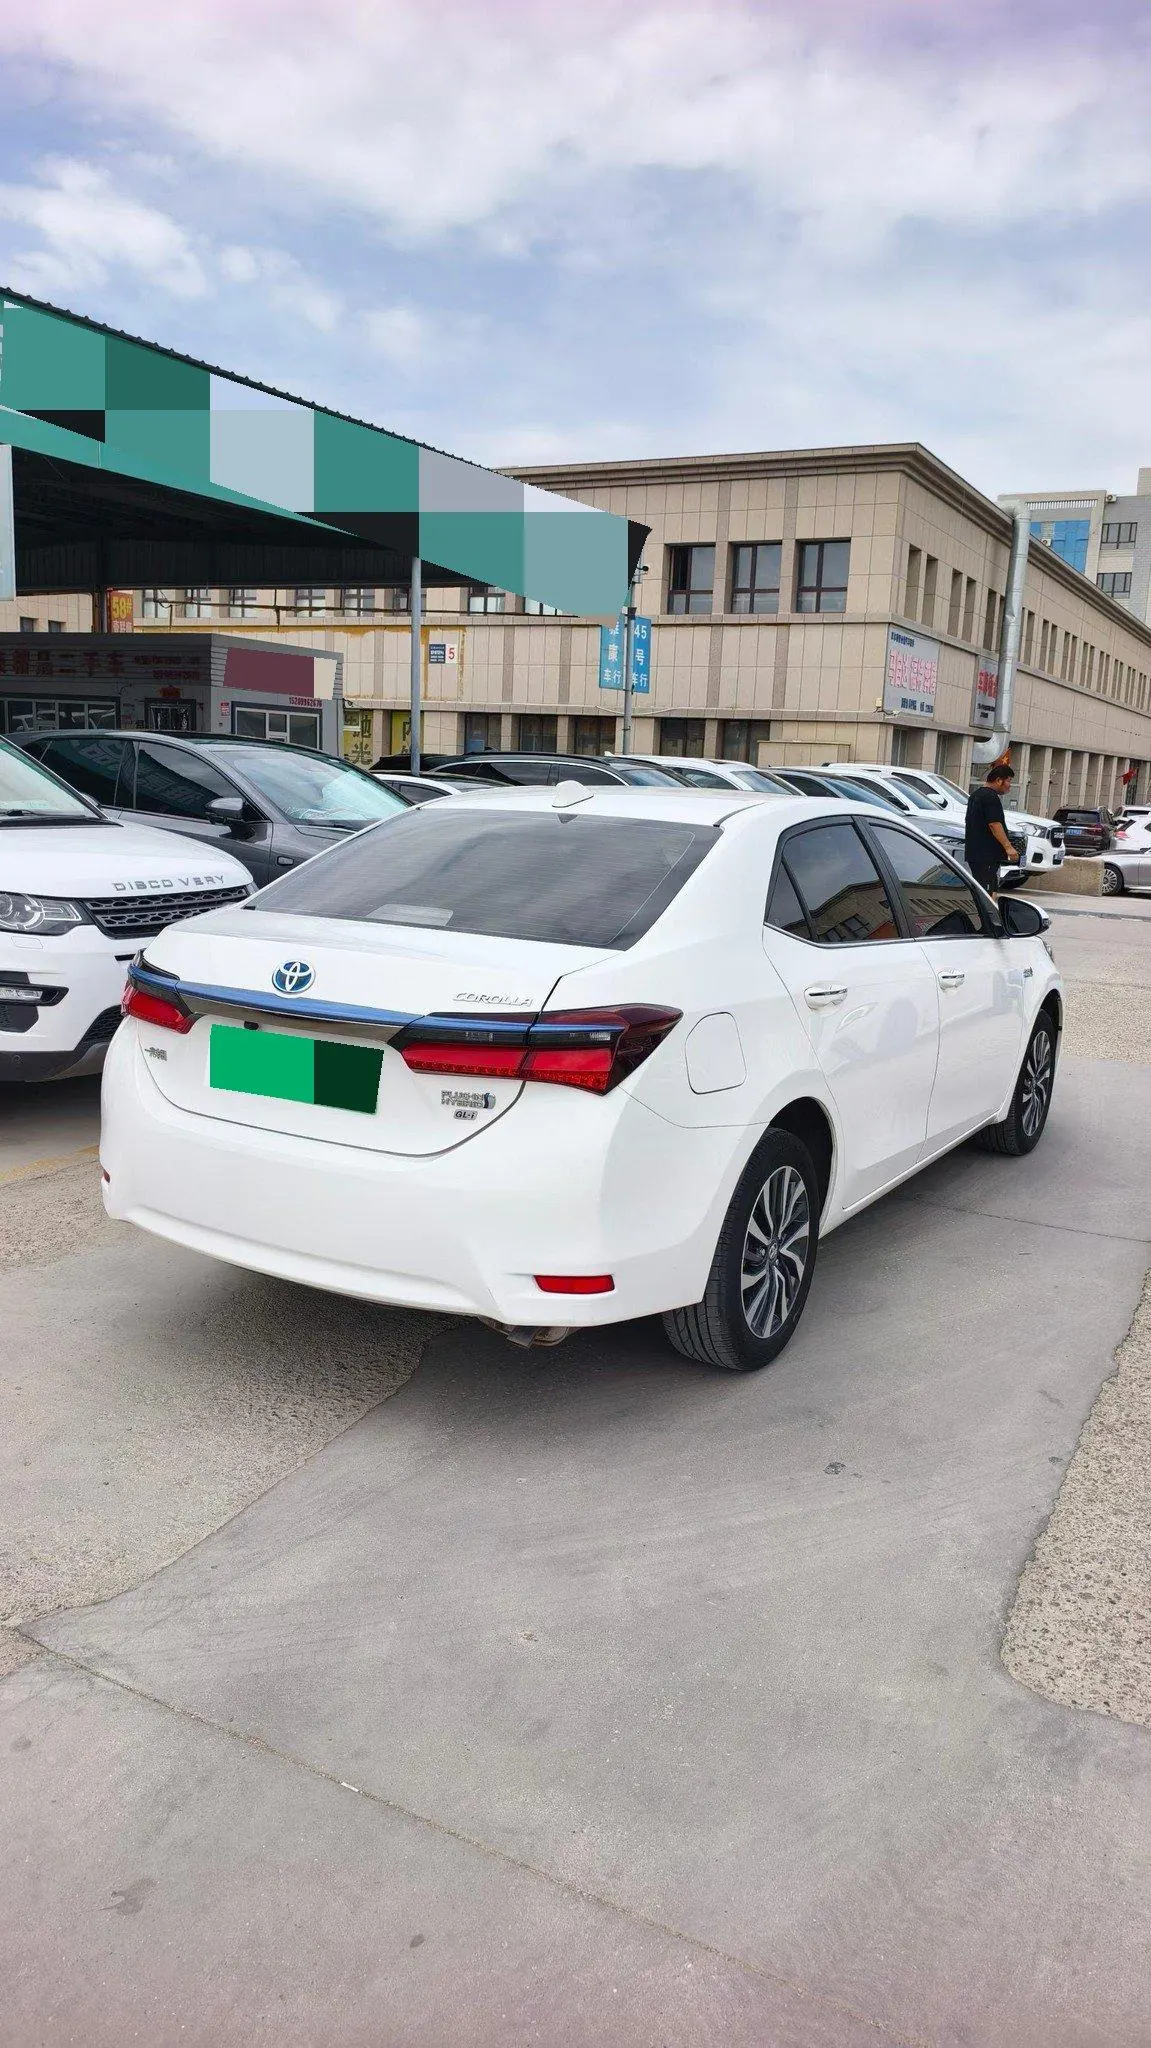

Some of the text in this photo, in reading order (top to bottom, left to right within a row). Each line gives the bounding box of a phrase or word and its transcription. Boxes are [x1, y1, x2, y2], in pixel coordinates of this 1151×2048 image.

[634, 625, 647, 640] 45
[448, 647, 455, 660] 5
[636, 649, 644, 666] 号
[603, 668, 621, 684] 车行
[112, 875, 224, 891] DISCOVERY
[454, 992, 534, 1007] COROLLA
[455, 1110, 475, 1119] GL-i
